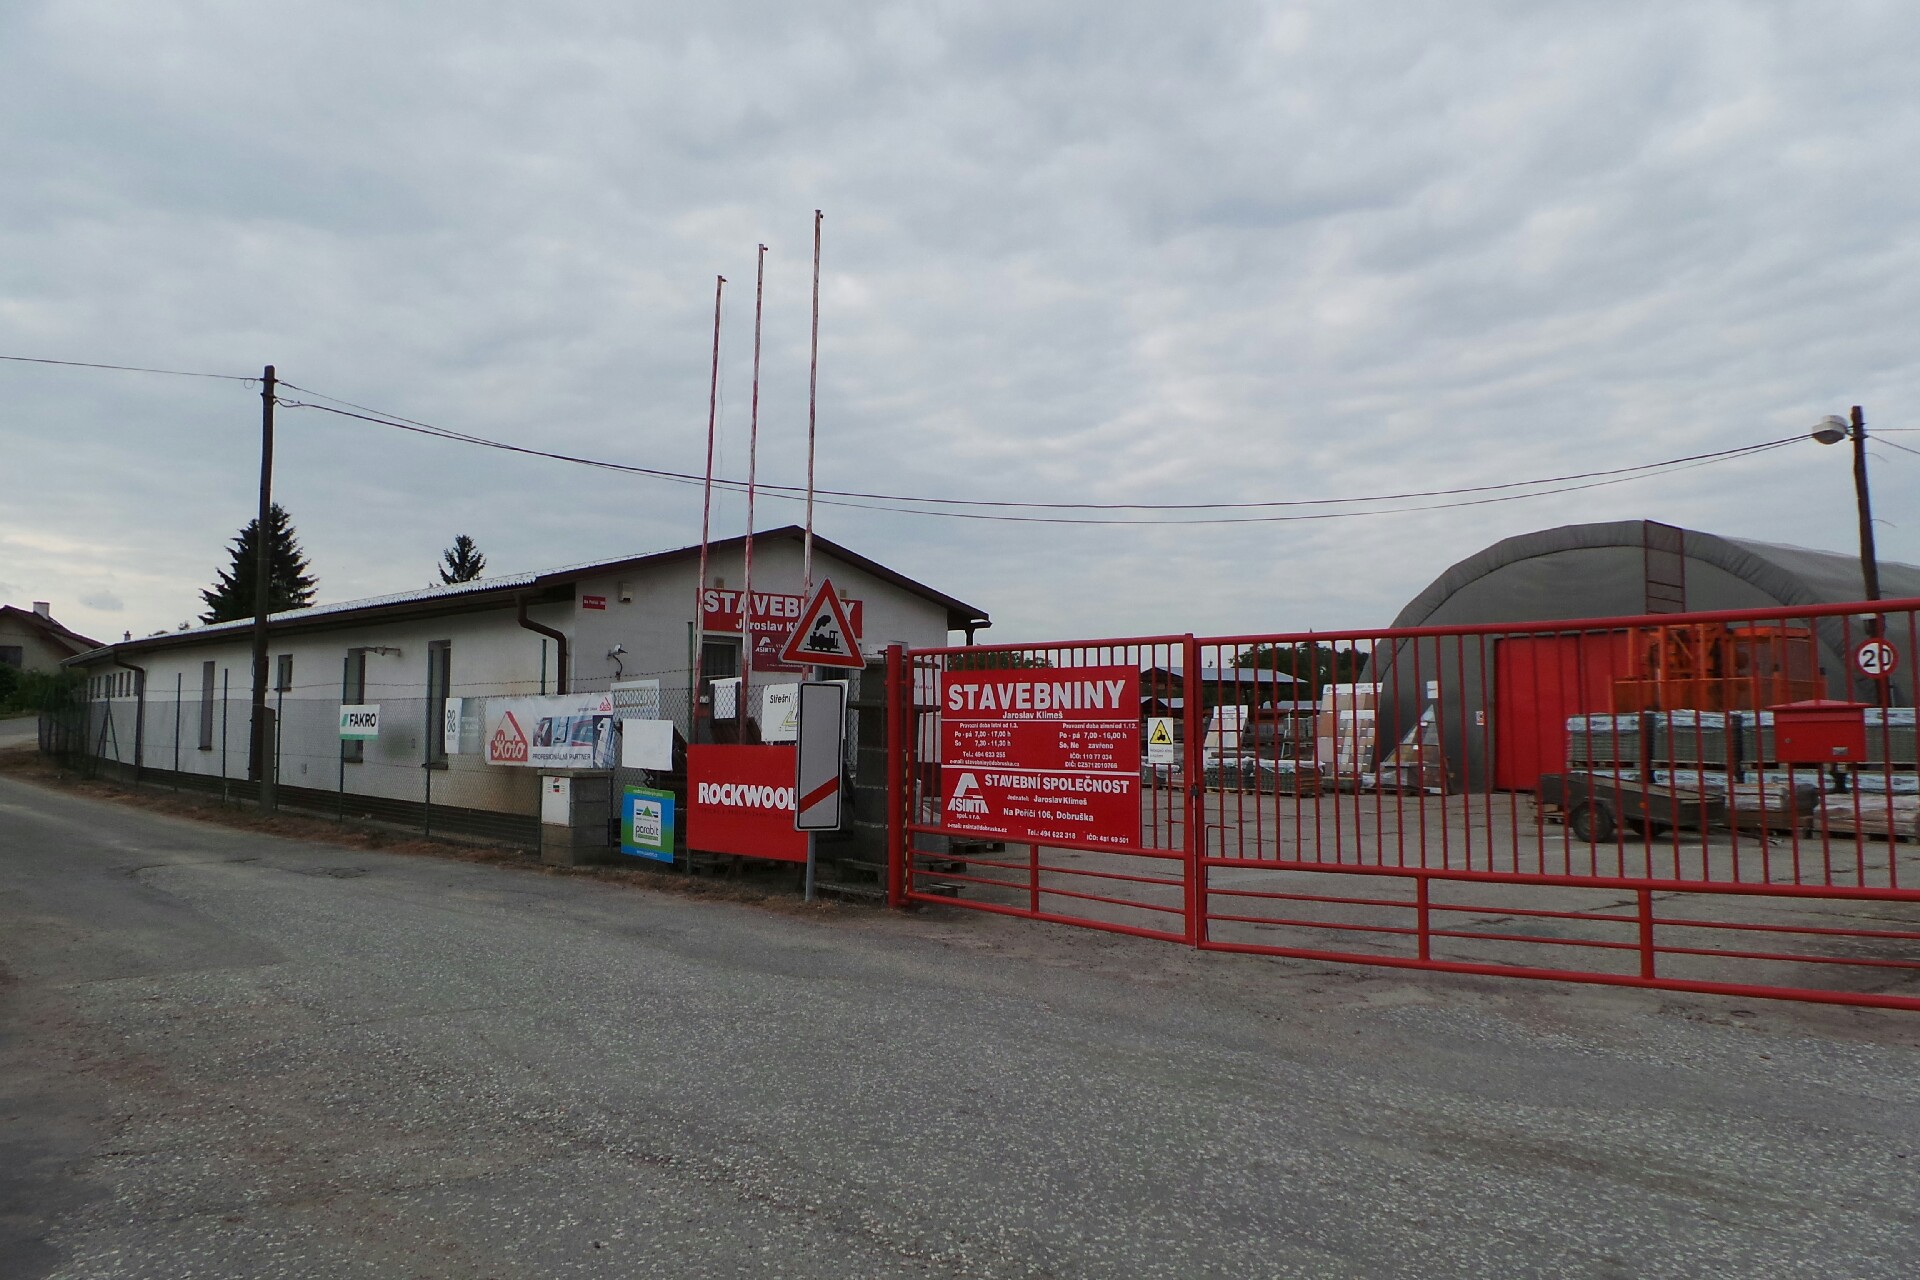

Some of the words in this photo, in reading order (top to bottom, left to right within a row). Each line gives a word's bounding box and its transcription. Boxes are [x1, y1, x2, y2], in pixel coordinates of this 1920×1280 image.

[704, 590, 855, 621] STAVEBY
[736, 618, 783, 632] Jroslav
[1862, 649, 1891, 668] 20
[770, 692, 792, 704] Střešní
[948, 680, 1126, 710] STAVEBNINY
[350, 712, 376, 728] FAKRO
[1002, 711, 1034, 720] Jaroslav
[1036, 710, 1063, 720] Klimeš
[1072, 732, 1080, 740] pá
[1103, 732, 1121, 740] 16,00
[492, 732, 525, 758] Roto
[984, 774, 1041, 790] STAVEBNÍ
[1043, 775, 1129, 794] SPOLEČNOST
[698, 782, 796, 810] ROCKWOOL
[1034, 795, 1062, 804] Jaroslav
[1063, 796, 1087, 806] Klimeš
[948, 798, 989, 814] ASINTA
[1003, 808, 1013, 816] Na
[1014, 808, 1036, 818] Poříčí
[1038, 810, 1053, 820] 106,
[1056, 811, 1094, 822] Dobruška
[636, 824, 659, 838] parabit
[1040, 830, 1050, 838] 494
